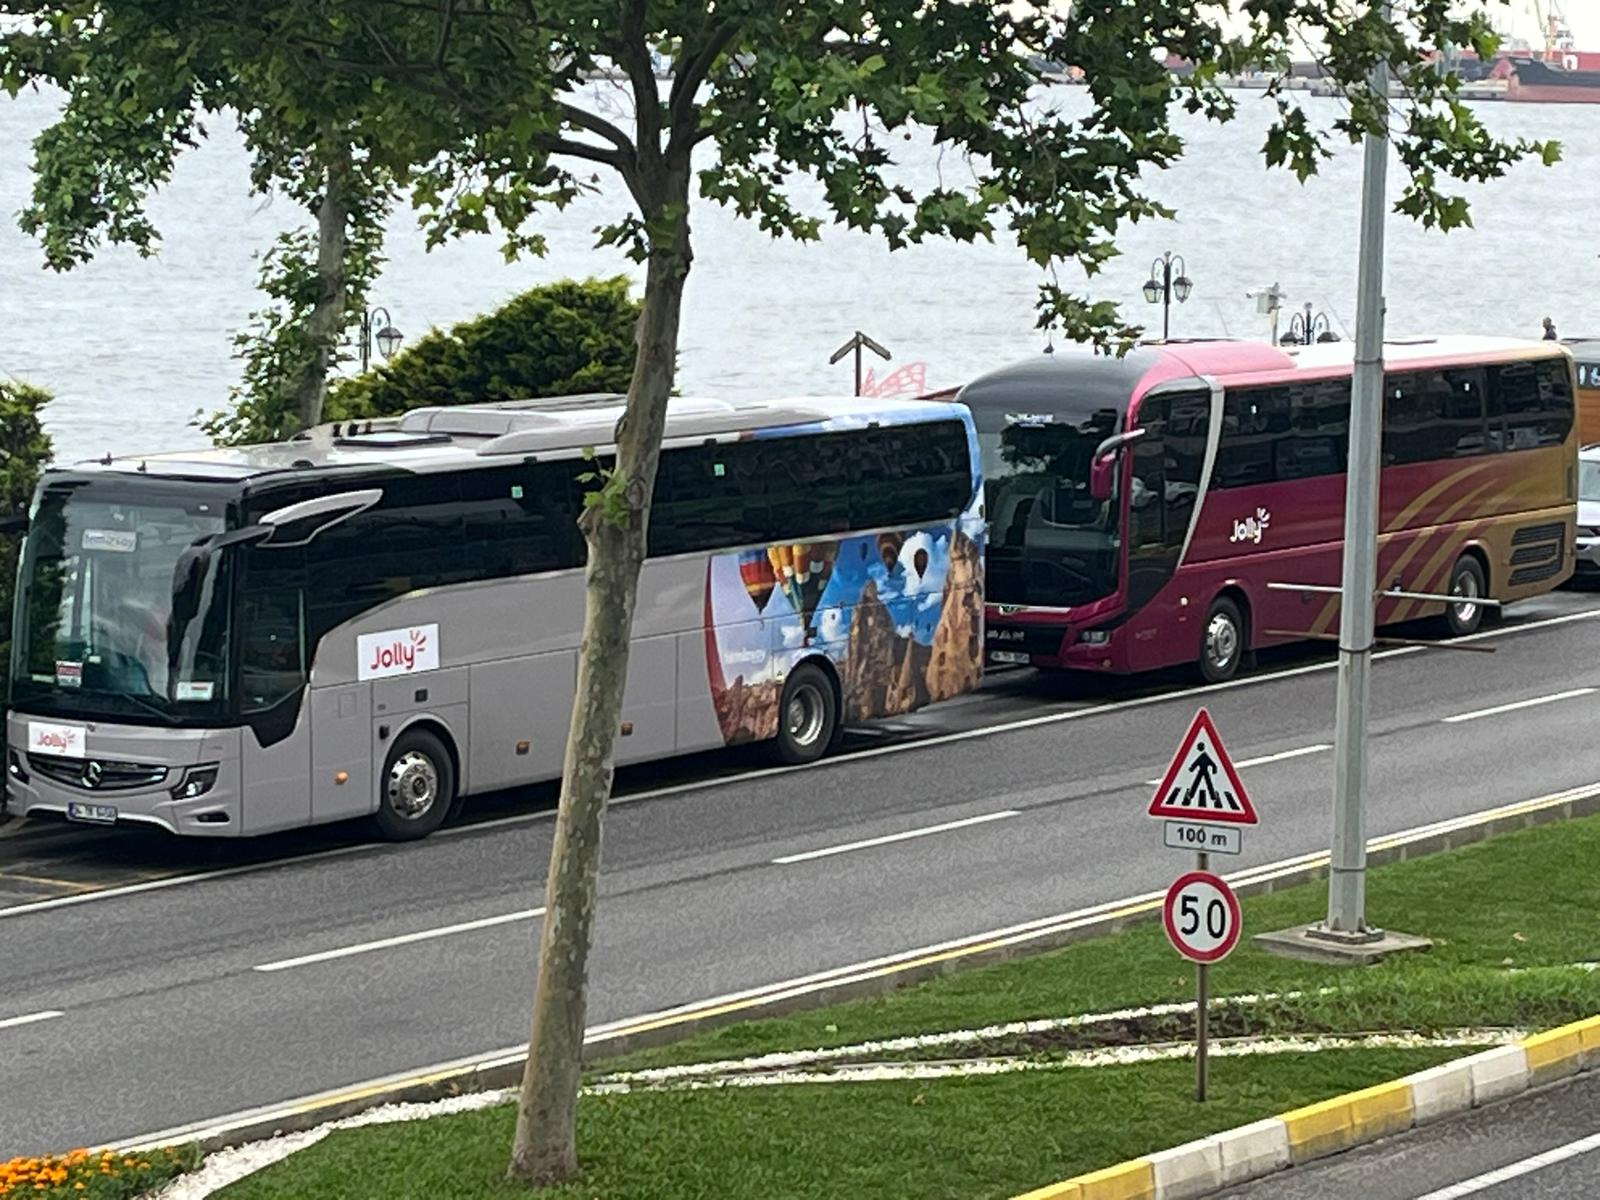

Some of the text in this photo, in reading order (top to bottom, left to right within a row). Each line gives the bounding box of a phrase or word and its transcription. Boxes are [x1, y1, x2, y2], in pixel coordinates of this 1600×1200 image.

[1229, 516, 1262, 544] Jolly
[370, 641, 415, 671] Jolly
[1177, 826, 1227, 847] 100 m
[1180, 894, 1226, 939] 50
